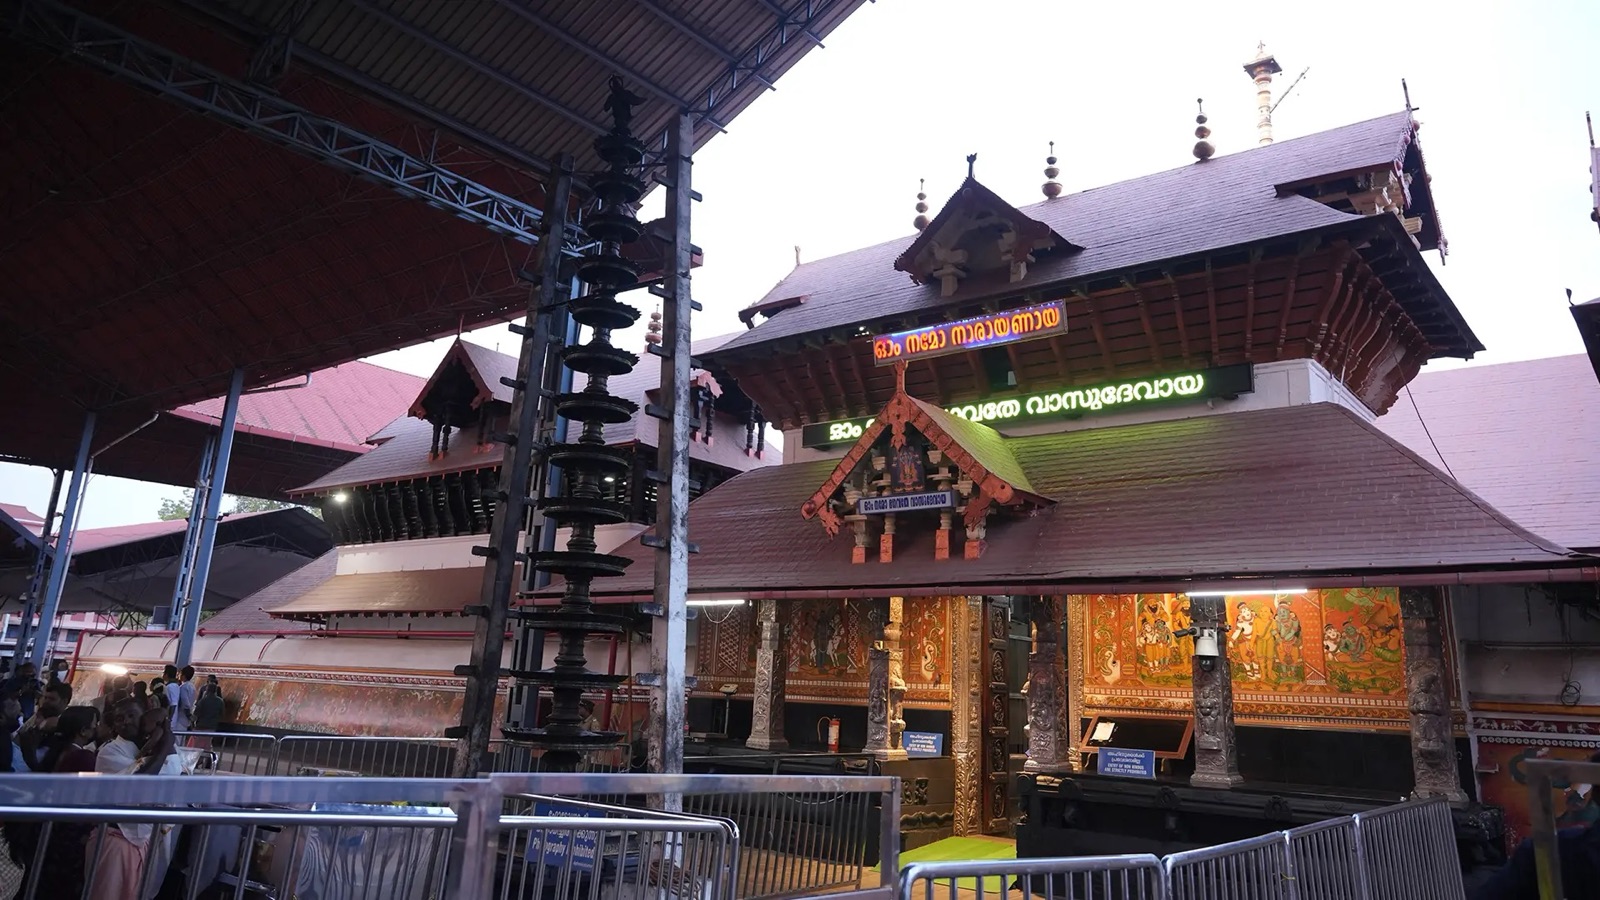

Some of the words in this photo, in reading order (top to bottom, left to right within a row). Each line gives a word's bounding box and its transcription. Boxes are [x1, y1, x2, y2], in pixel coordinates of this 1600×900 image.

[874, 339, 902, 359] ഓം
[906, 331, 946, 354] നമോ
[951, 306, 1060, 346] നാരായണായ
[829, 422, 863, 441] ഓം
[1026, 373, 1204, 415] വാസുദേവായ
